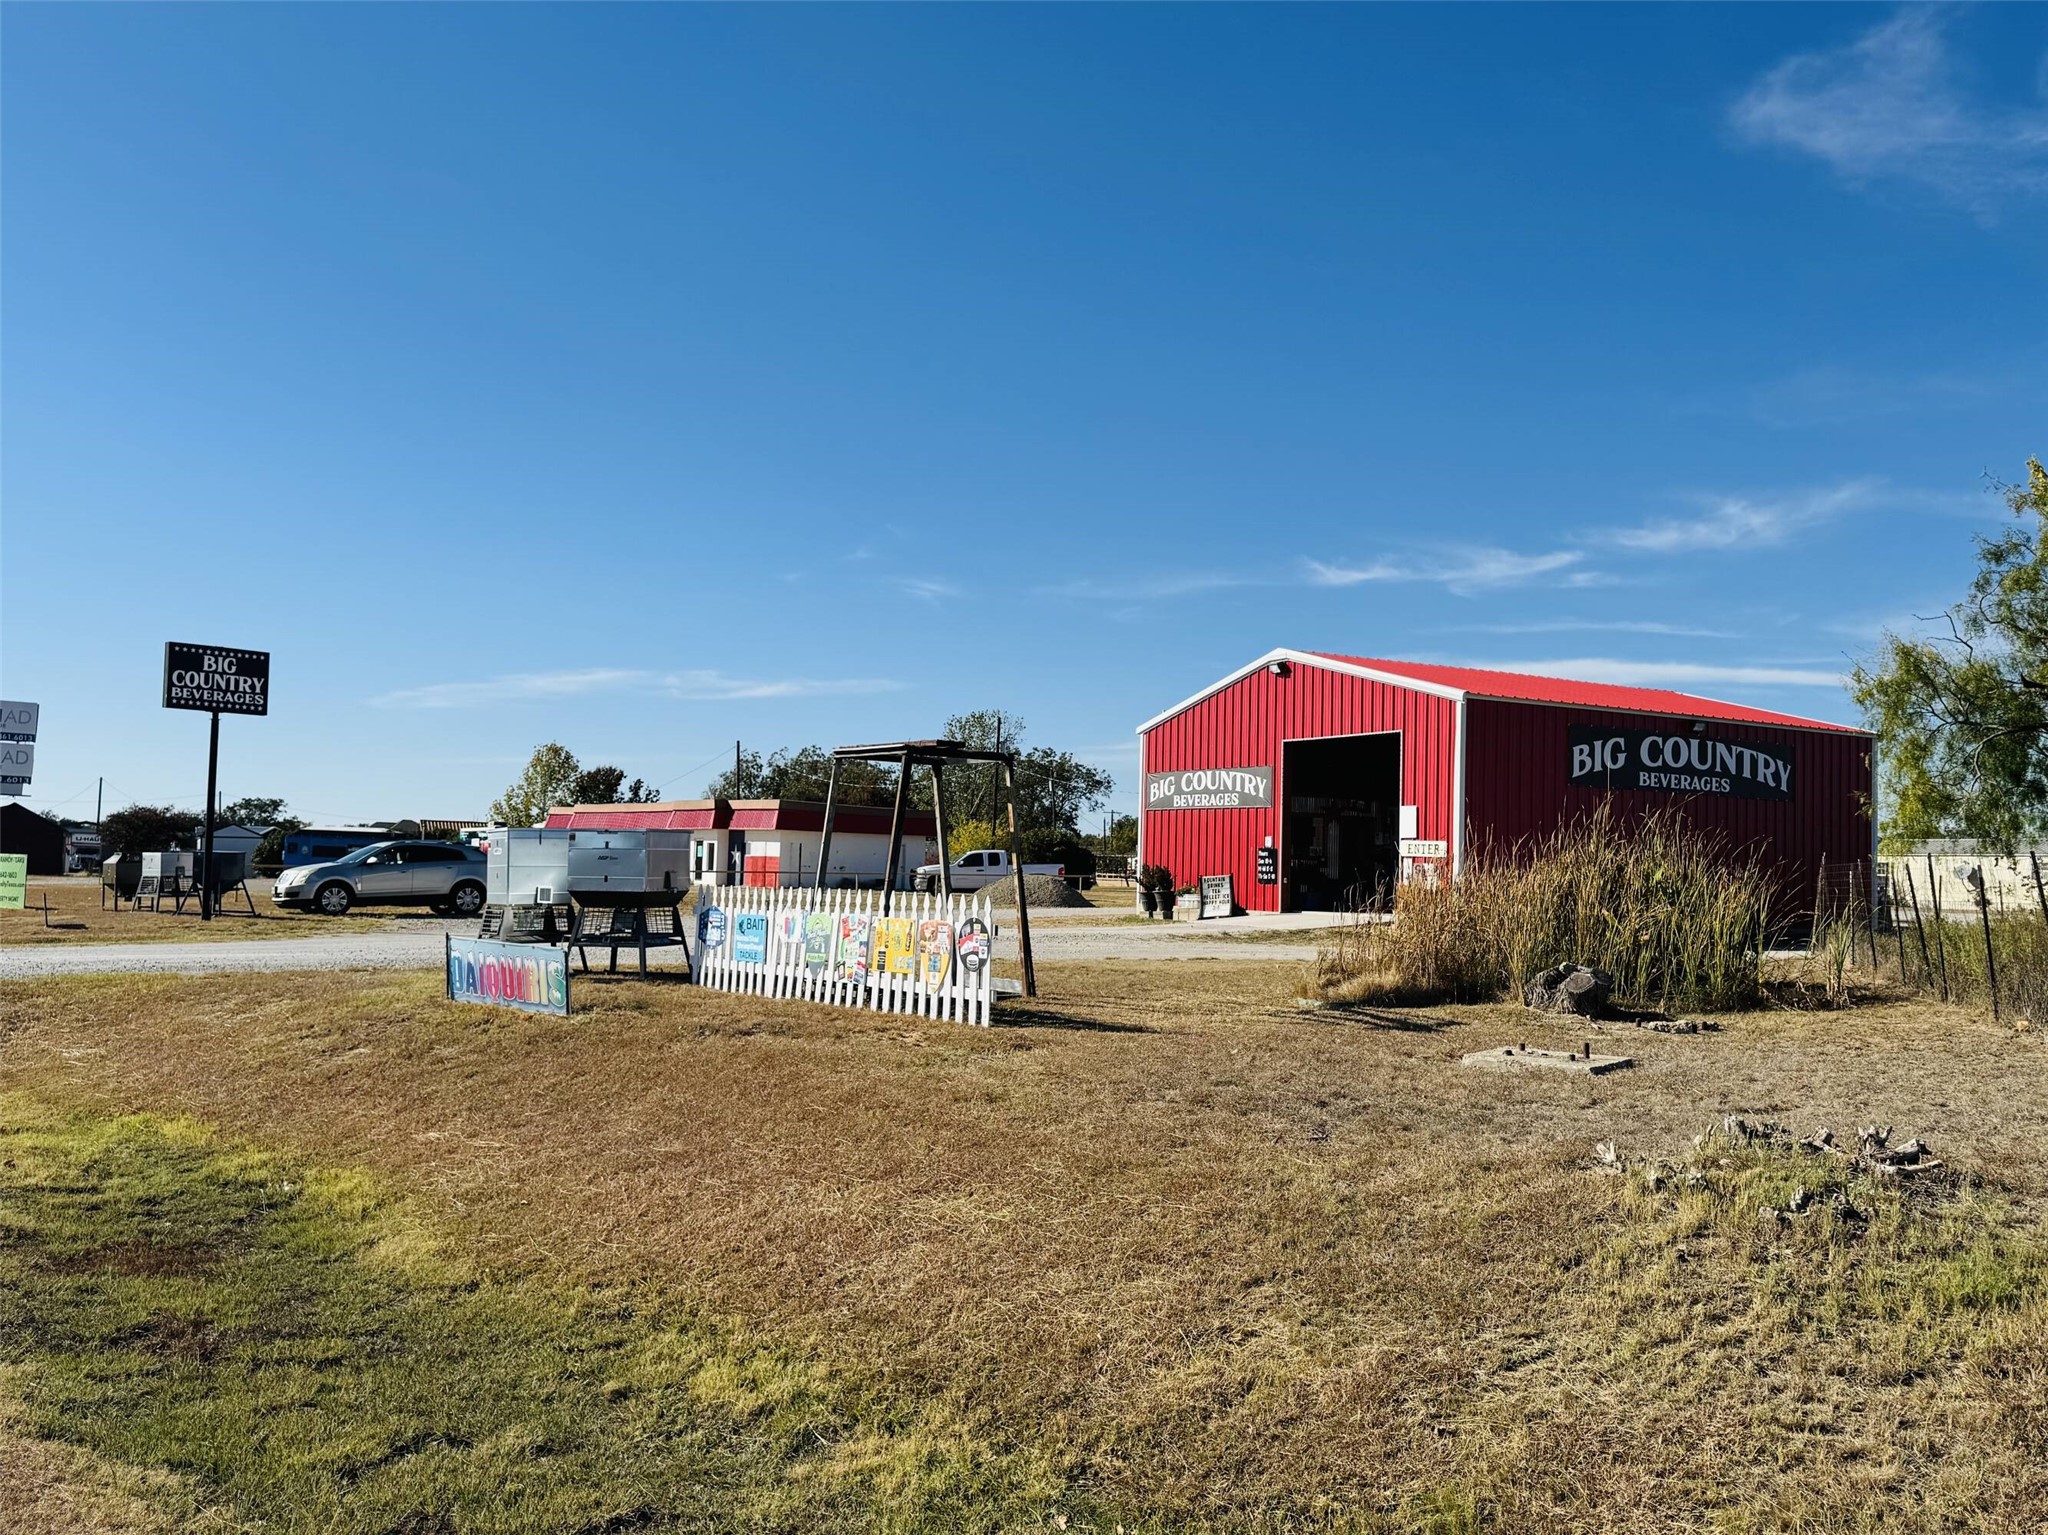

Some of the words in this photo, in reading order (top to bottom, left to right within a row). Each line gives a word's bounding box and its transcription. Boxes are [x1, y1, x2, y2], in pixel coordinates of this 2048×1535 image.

[203, 655, 237, 673] BIG
[172, 670, 264, 693] COUNTRY
[171, 687, 264, 704] BEVERAGES
[1572, 737, 1627, 778] BIG
[1640, 736, 1791, 793] COUNTRY
[1150, 776, 1175, 803] BIG
[1181, 771, 1267, 798] COUNTRY
[1639, 772, 1730, 793] BEVERAGES
[1173, 793, 1239, 807] BEVERAGES
[1407, 843, 1440, 855] ENTER
[746, 918, 766, 931] BAIT
[739, 950, 758, 960] TACKLE
[450, 950, 567, 1008] DAIQUIRIS
